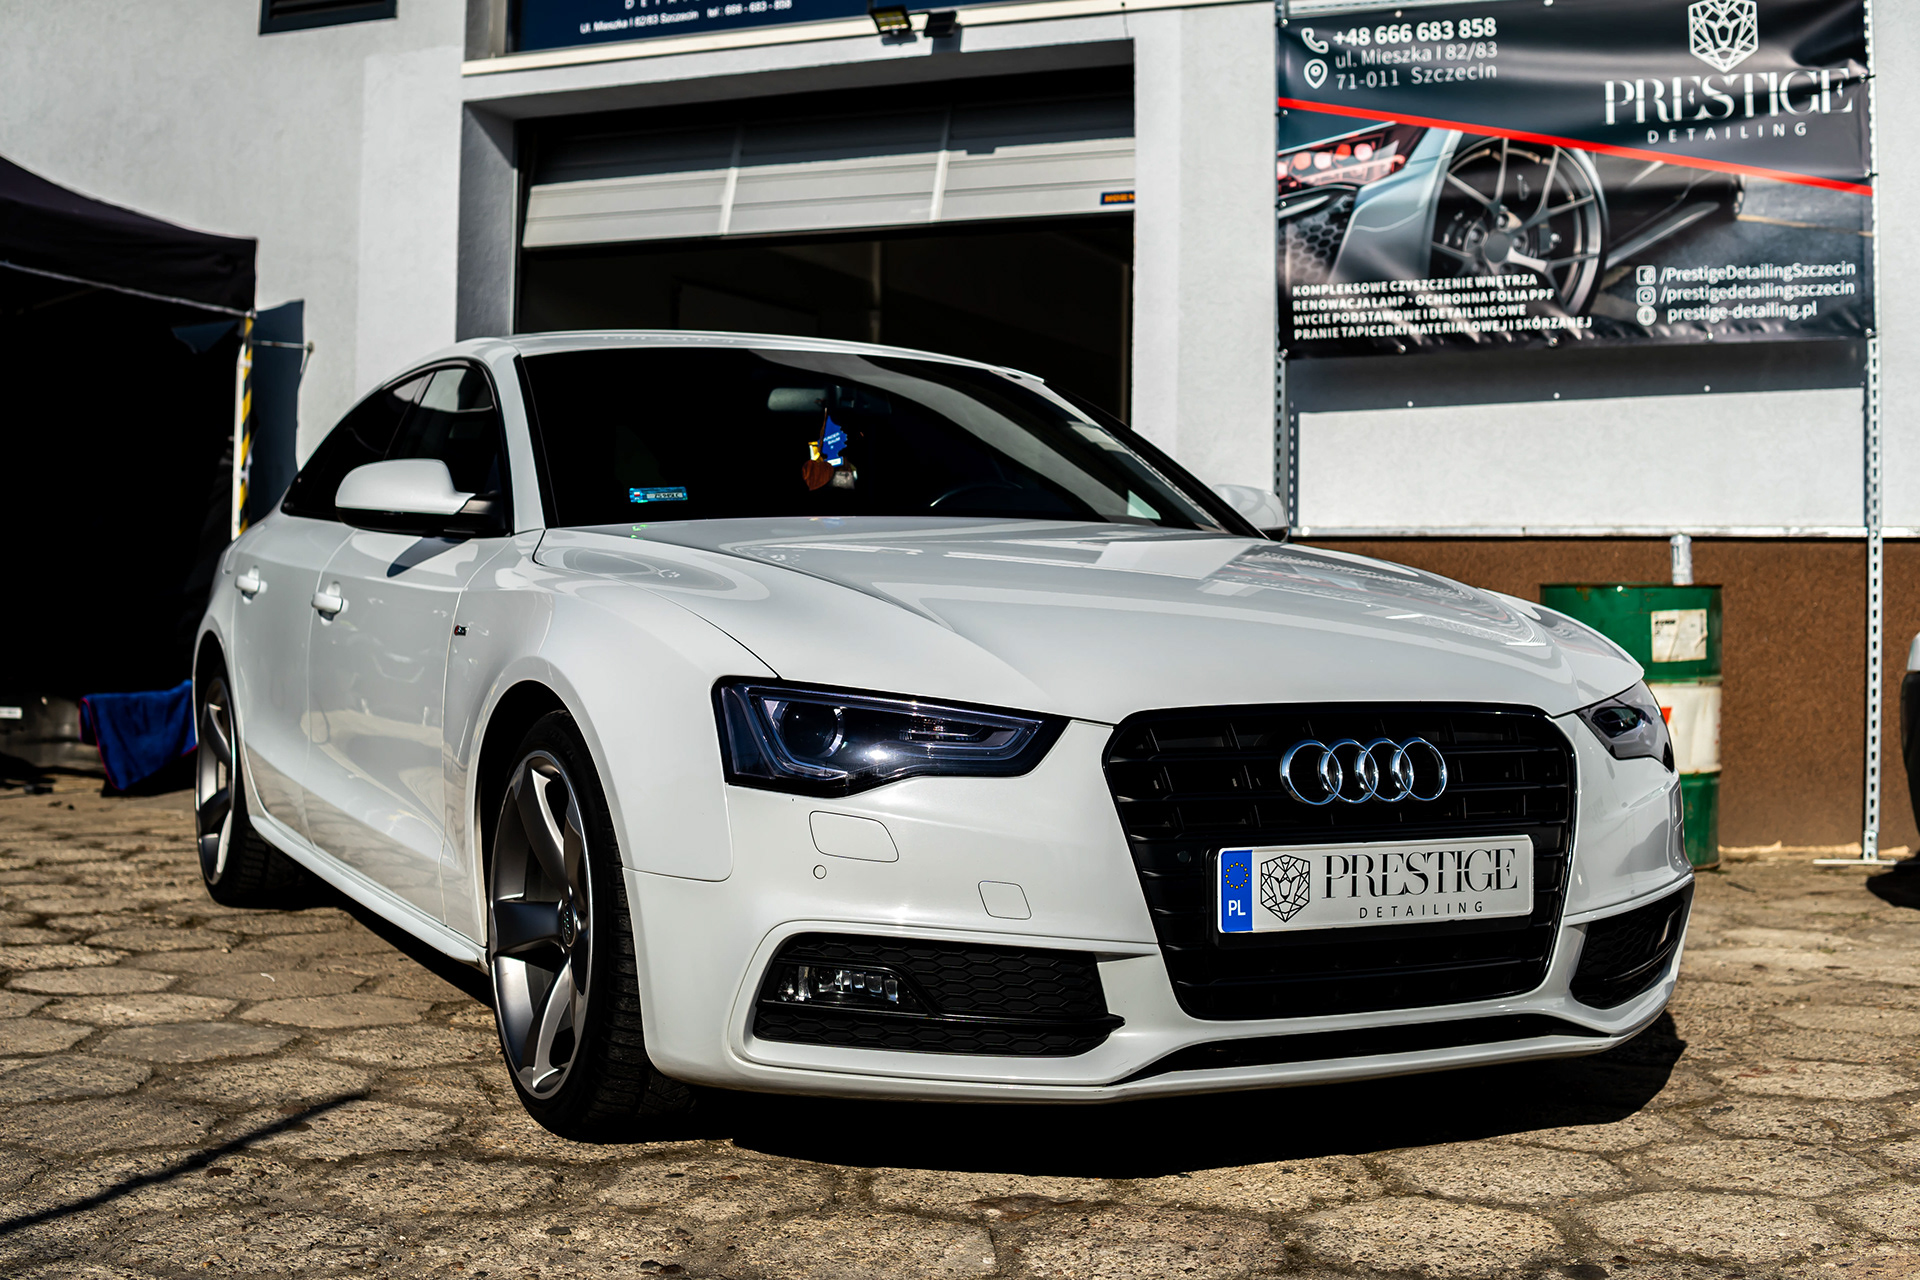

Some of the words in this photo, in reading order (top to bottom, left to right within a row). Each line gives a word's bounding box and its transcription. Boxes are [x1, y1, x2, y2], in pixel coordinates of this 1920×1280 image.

[1333, 27, 1371, 46] +48
[1374, 23, 1413, 45] 666
[1415, 20, 1454, 42] 683
[1458, 17, 1497, 38] 858
[1335, 50, 1358, 68] ul.
[1361, 45, 1432, 65] Mieszka
[1445, 41, 1497, 62] 82/83
[1336, 69, 1400, 90] 71-011
[1411, 62, 1497, 84] Szczecin
[1603, 67, 1853, 125] PRESTIGE
[1647, 122, 1807, 144] DETAILING
[1292, 281, 1388, 297] KOMPLEKSOWE
[1389, 277, 1473, 292] CZYSZCZENIE
[1475, 273, 1538, 289] WNĘTRZA
[1659, 261, 1856, 285] /PrestigeDetailingSzczecin
[1292, 297, 1370, 311] RENOWACJA
[1371, 295, 1406, 308] LAMP
[1415, 291, 1488, 306] OCHRONNA
[1489, 289, 1528, 303] FOLIA
[1529, 288, 1555, 300] PPF
[1660, 280, 1855, 304] /prestigedetailingszczecin
[1293, 313, 1330, 326] MYCIE
[1332, 309, 1422, 324] PODSTAWOWE
[1429, 303, 1526, 319] DETAILINGOWE
[1667, 300, 1817, 325] prestige-detailing.pl
[1294, 327, 1339, 340] PRANIE
[1340, 324, 1407, 338] TAPICERKI
[1515, 315, 1592, 331] SKÓRZANEJ
[1321, 848, 1518, 899] PRESTIGE
[1228, 899, 1246, 917] PL
[1359, 901, 1483, 919] DETAILING
